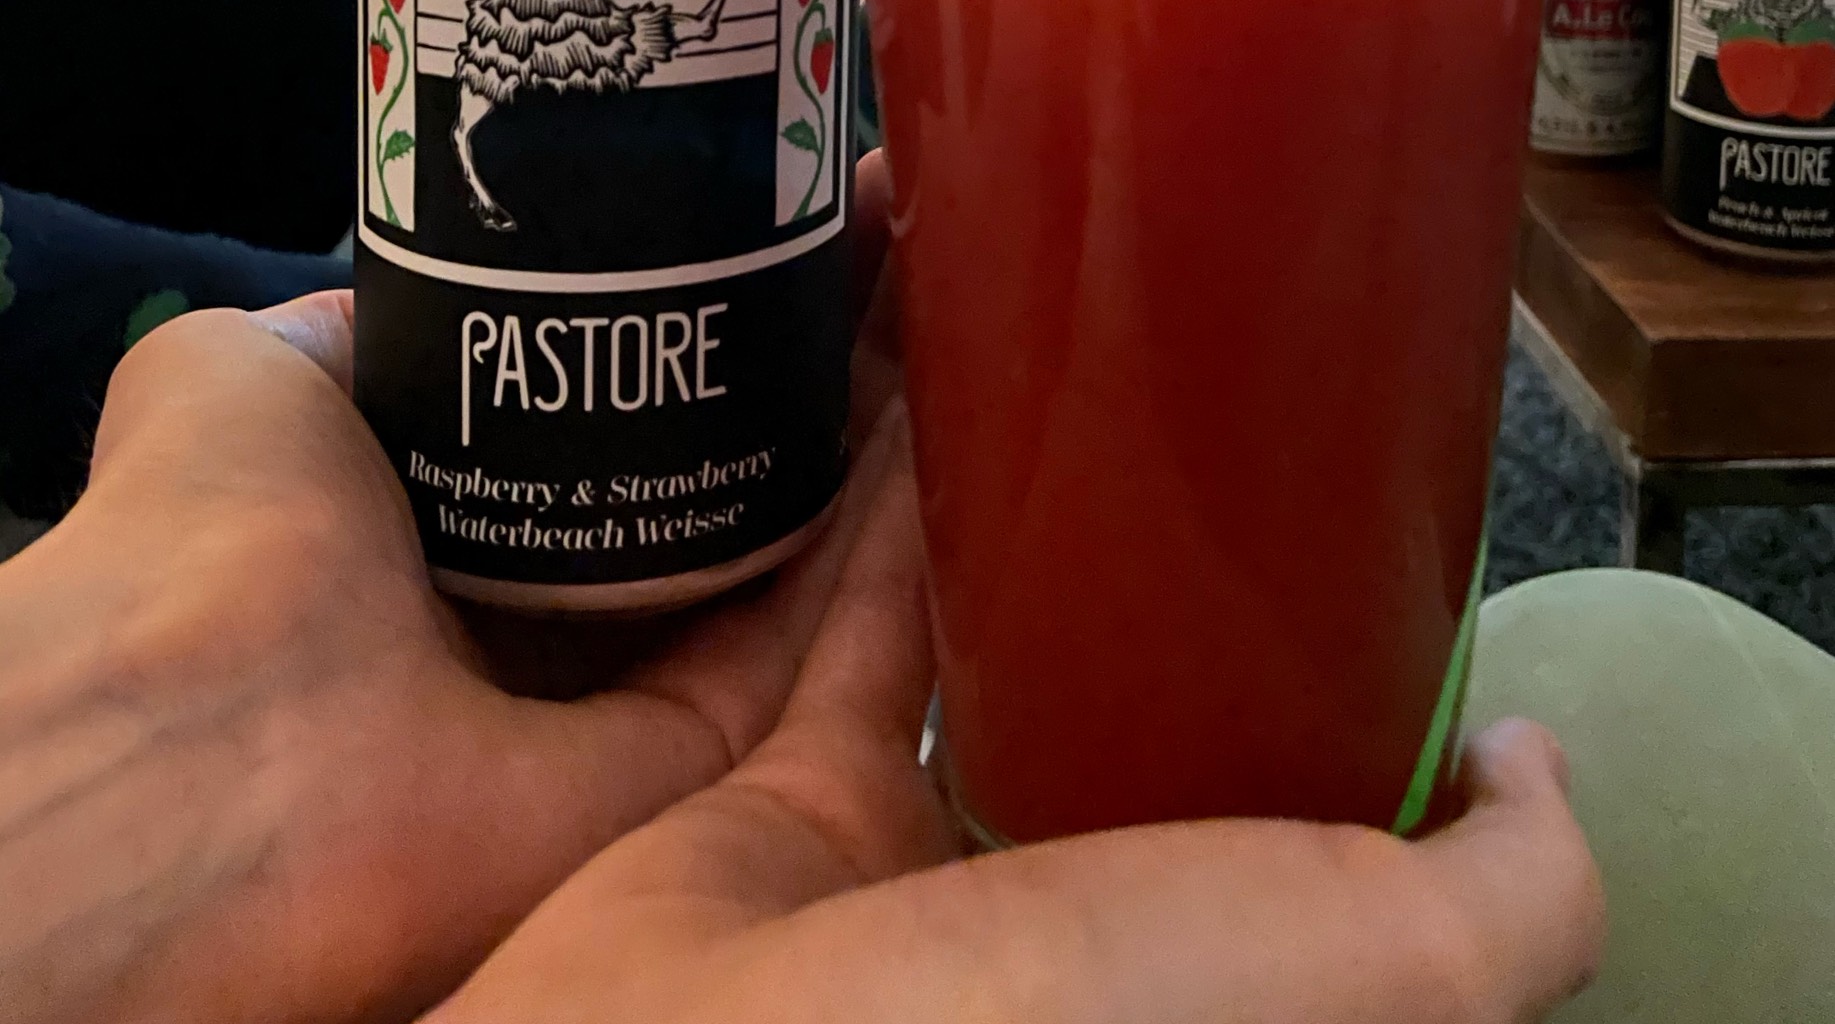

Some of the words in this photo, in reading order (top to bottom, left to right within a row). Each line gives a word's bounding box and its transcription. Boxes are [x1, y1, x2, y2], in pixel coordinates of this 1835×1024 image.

[1719, 136, 1833, 191] PASTORE
[461, 302, 729, 447] PASTORE
[408, 449, 562, 513] Raspberry
[571, 479, 596, 507] &
[606, 446, 778, 504] Strawberry
[438, 503, 624, 551] Waterbeach
[636, 501, 745, 546] Weisse
